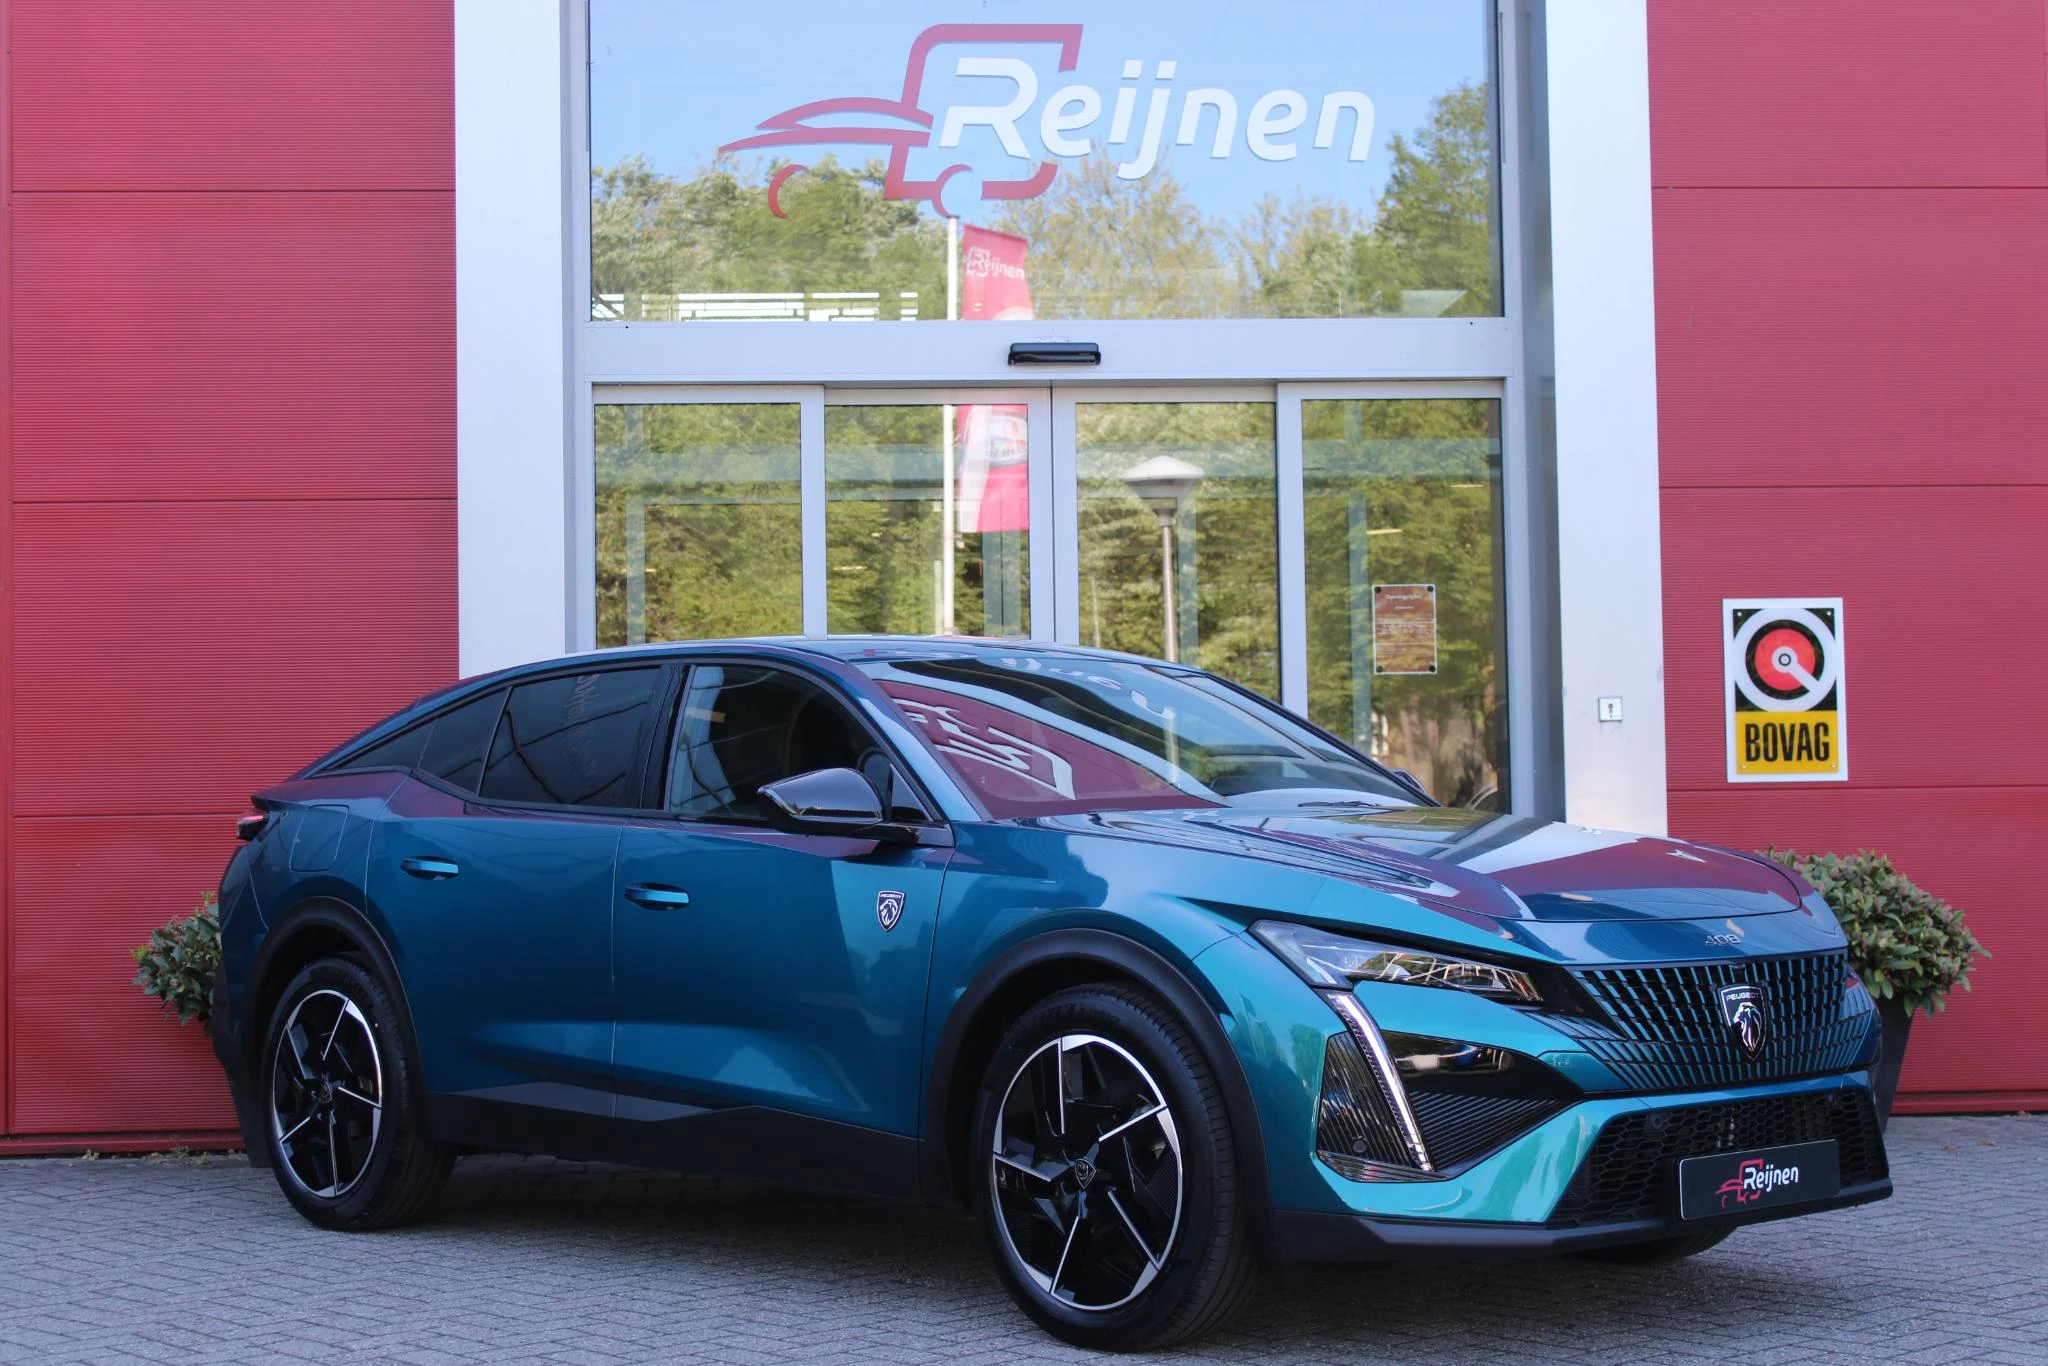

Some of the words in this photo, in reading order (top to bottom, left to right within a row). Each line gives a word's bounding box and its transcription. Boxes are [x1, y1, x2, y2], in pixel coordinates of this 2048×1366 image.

[938, 57, 1376, 181] Reijnen
[970, 251, 1025, 280] Reijnen
[1745, 722, 1830, 762] BOVAG
[1705, 934, 1741, 945] 408
[1725, 991, 1759, 1001] PEUGEOT
[1743, 1164, 1799, 1192] Reijnen
